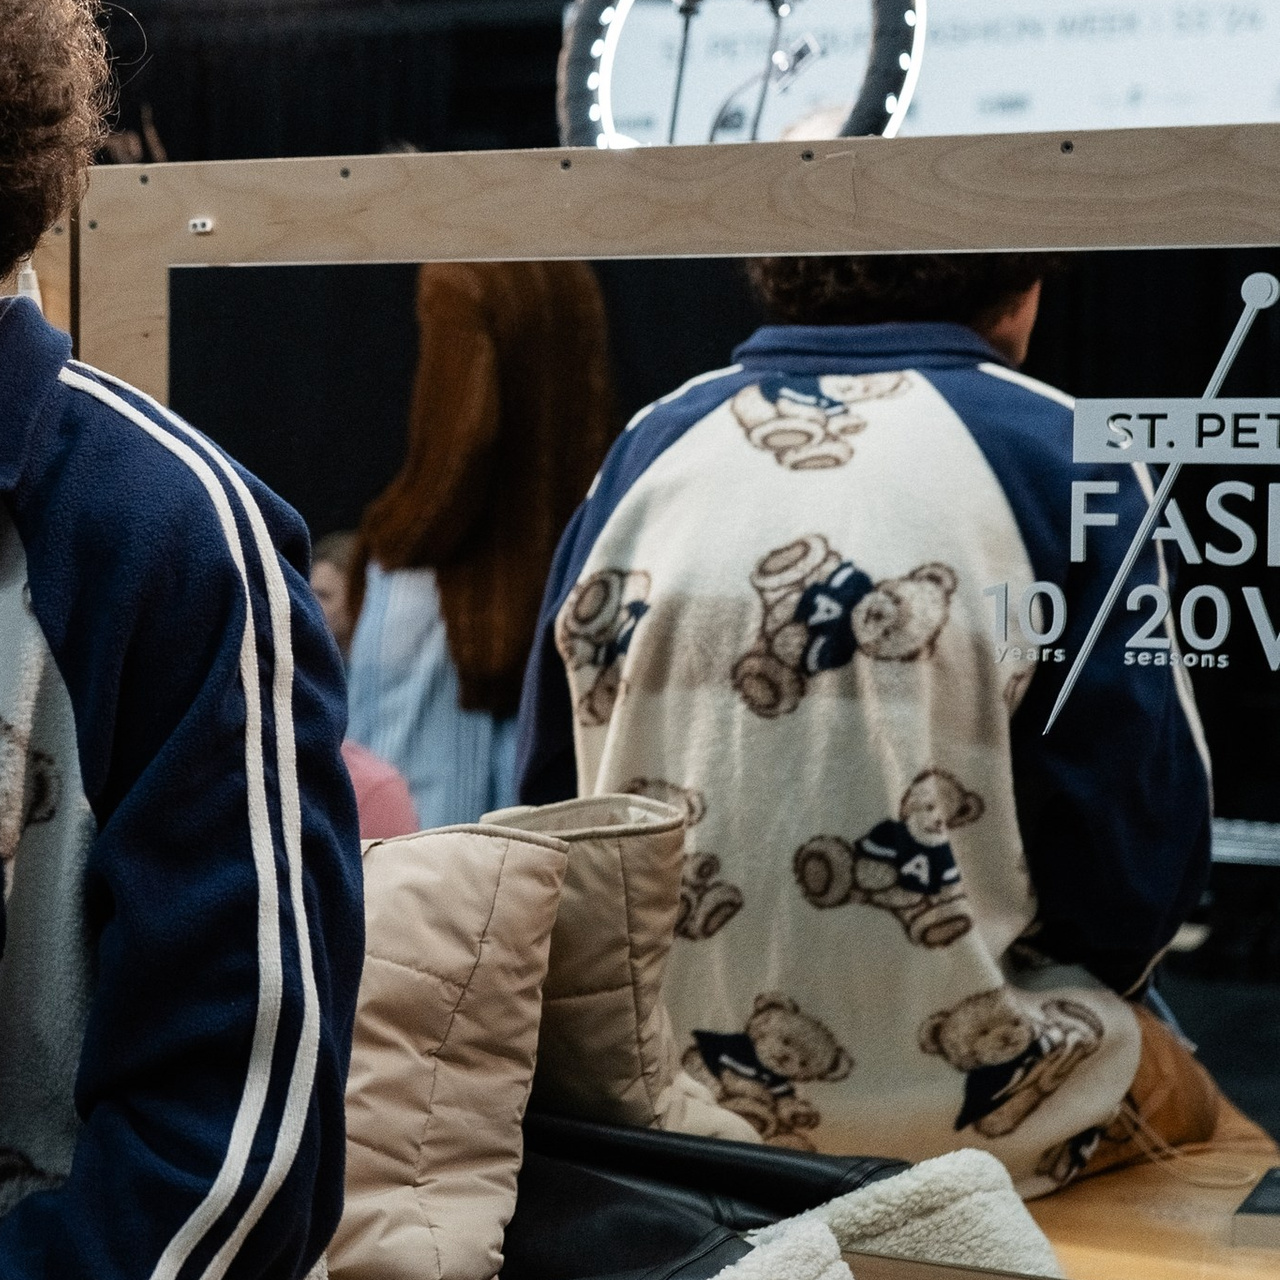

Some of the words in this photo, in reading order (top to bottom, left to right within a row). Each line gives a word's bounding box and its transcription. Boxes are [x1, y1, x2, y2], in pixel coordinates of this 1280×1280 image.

[1106, 412, 1175, 451] ST.
[1070, 480, 1280, 567] FAS
[982, 581, 1067, 646] 10
[1125, 583, 1231, 651] 20
[994, 646, 1067, 663] years
[1123, 649, 1230, 669] seasons
